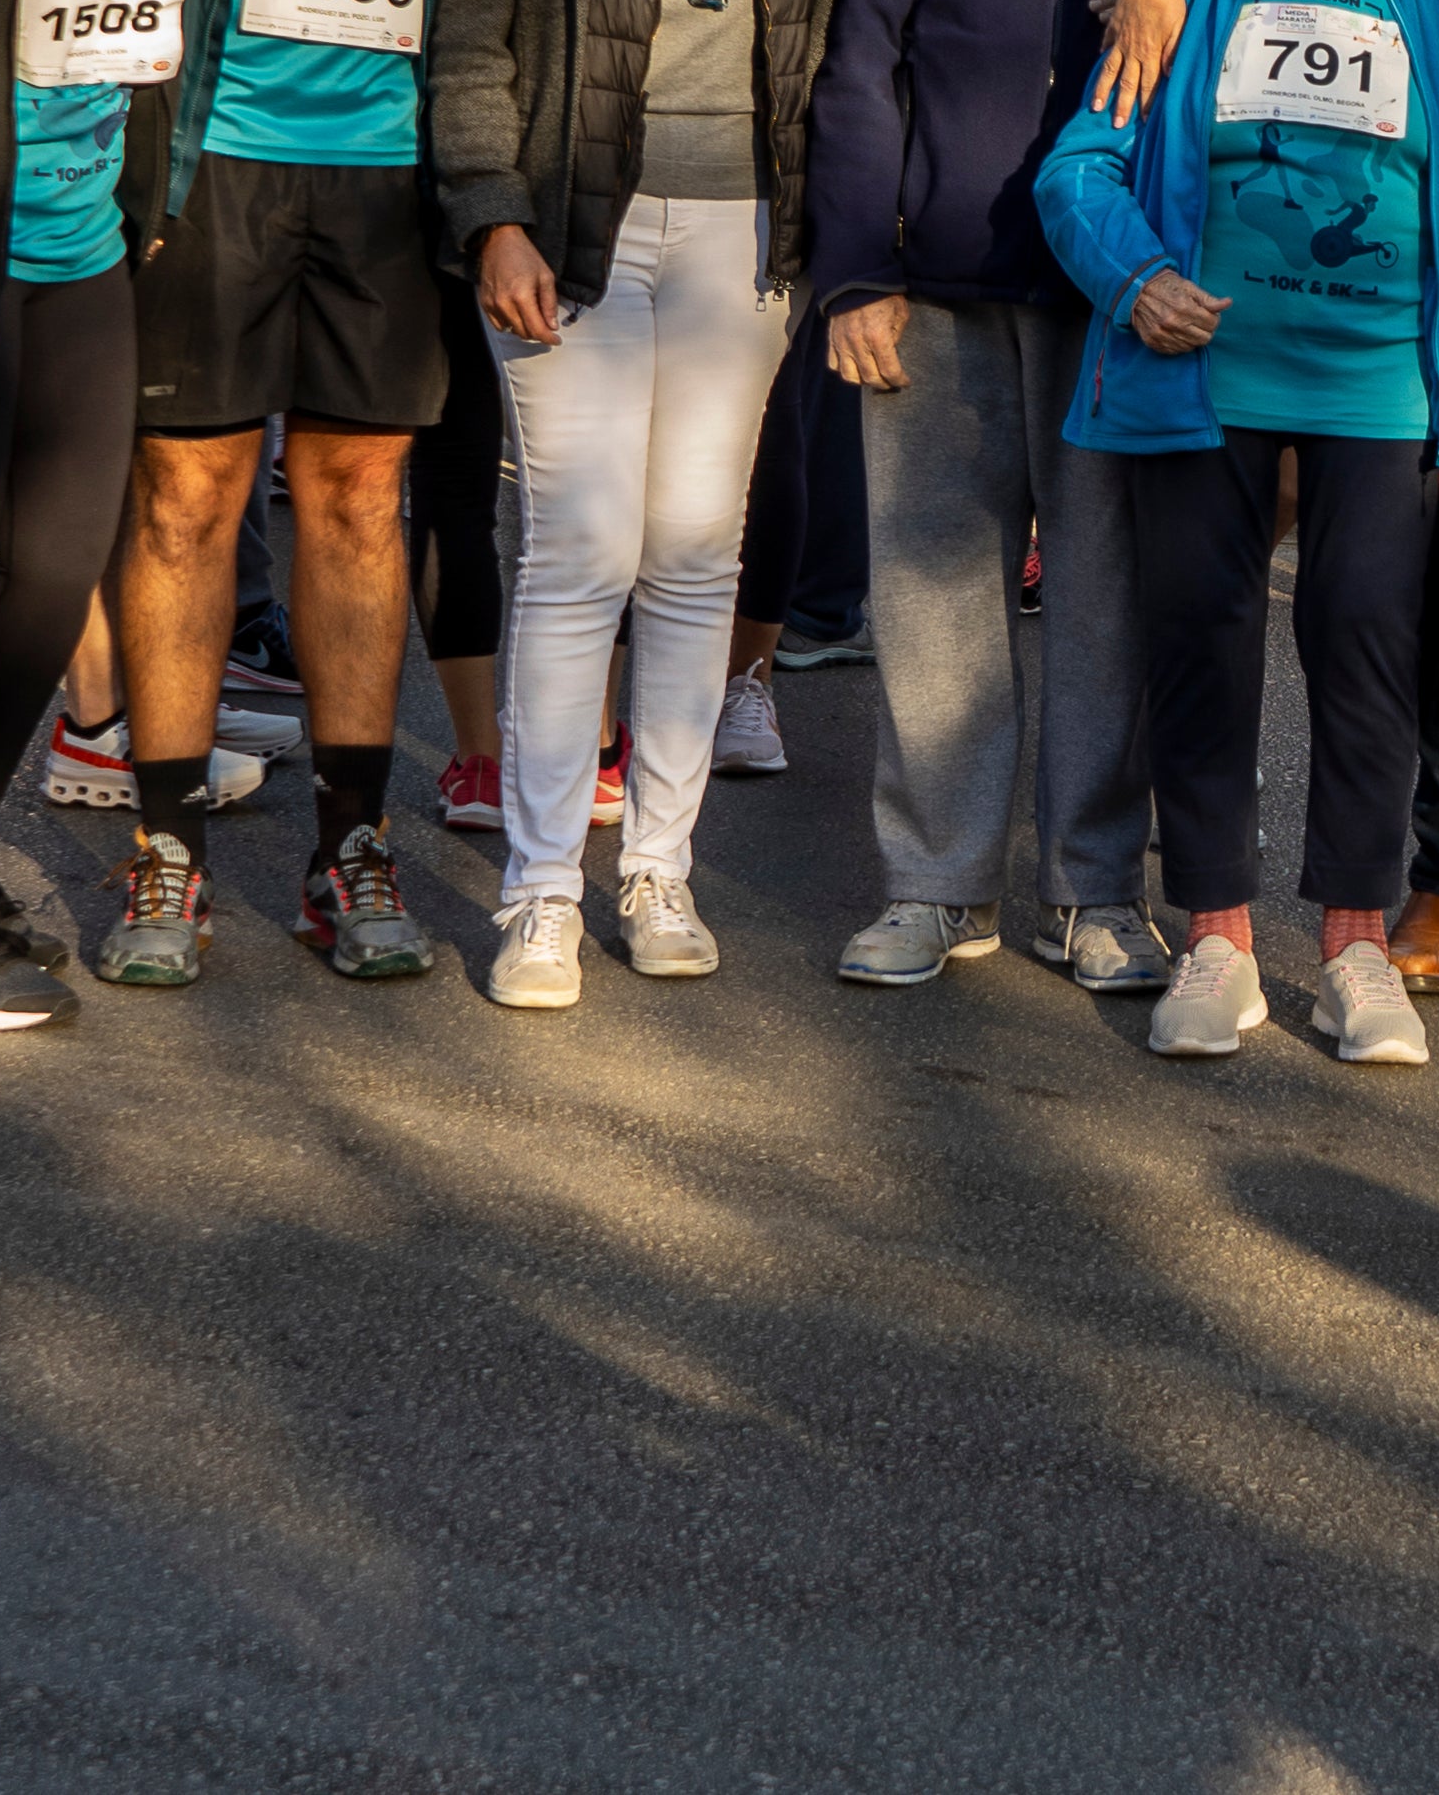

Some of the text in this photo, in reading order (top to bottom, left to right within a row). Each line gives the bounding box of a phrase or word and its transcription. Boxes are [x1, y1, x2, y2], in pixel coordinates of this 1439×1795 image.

[41, 0, 162, 41] 1508
[1264, 39, 1372, 93] 791
[1262, 89, 1366, 108] CISNEROS DEL OLMO, BEGOÑA
[1269, 275, 1353, 297] 10K & 5K
